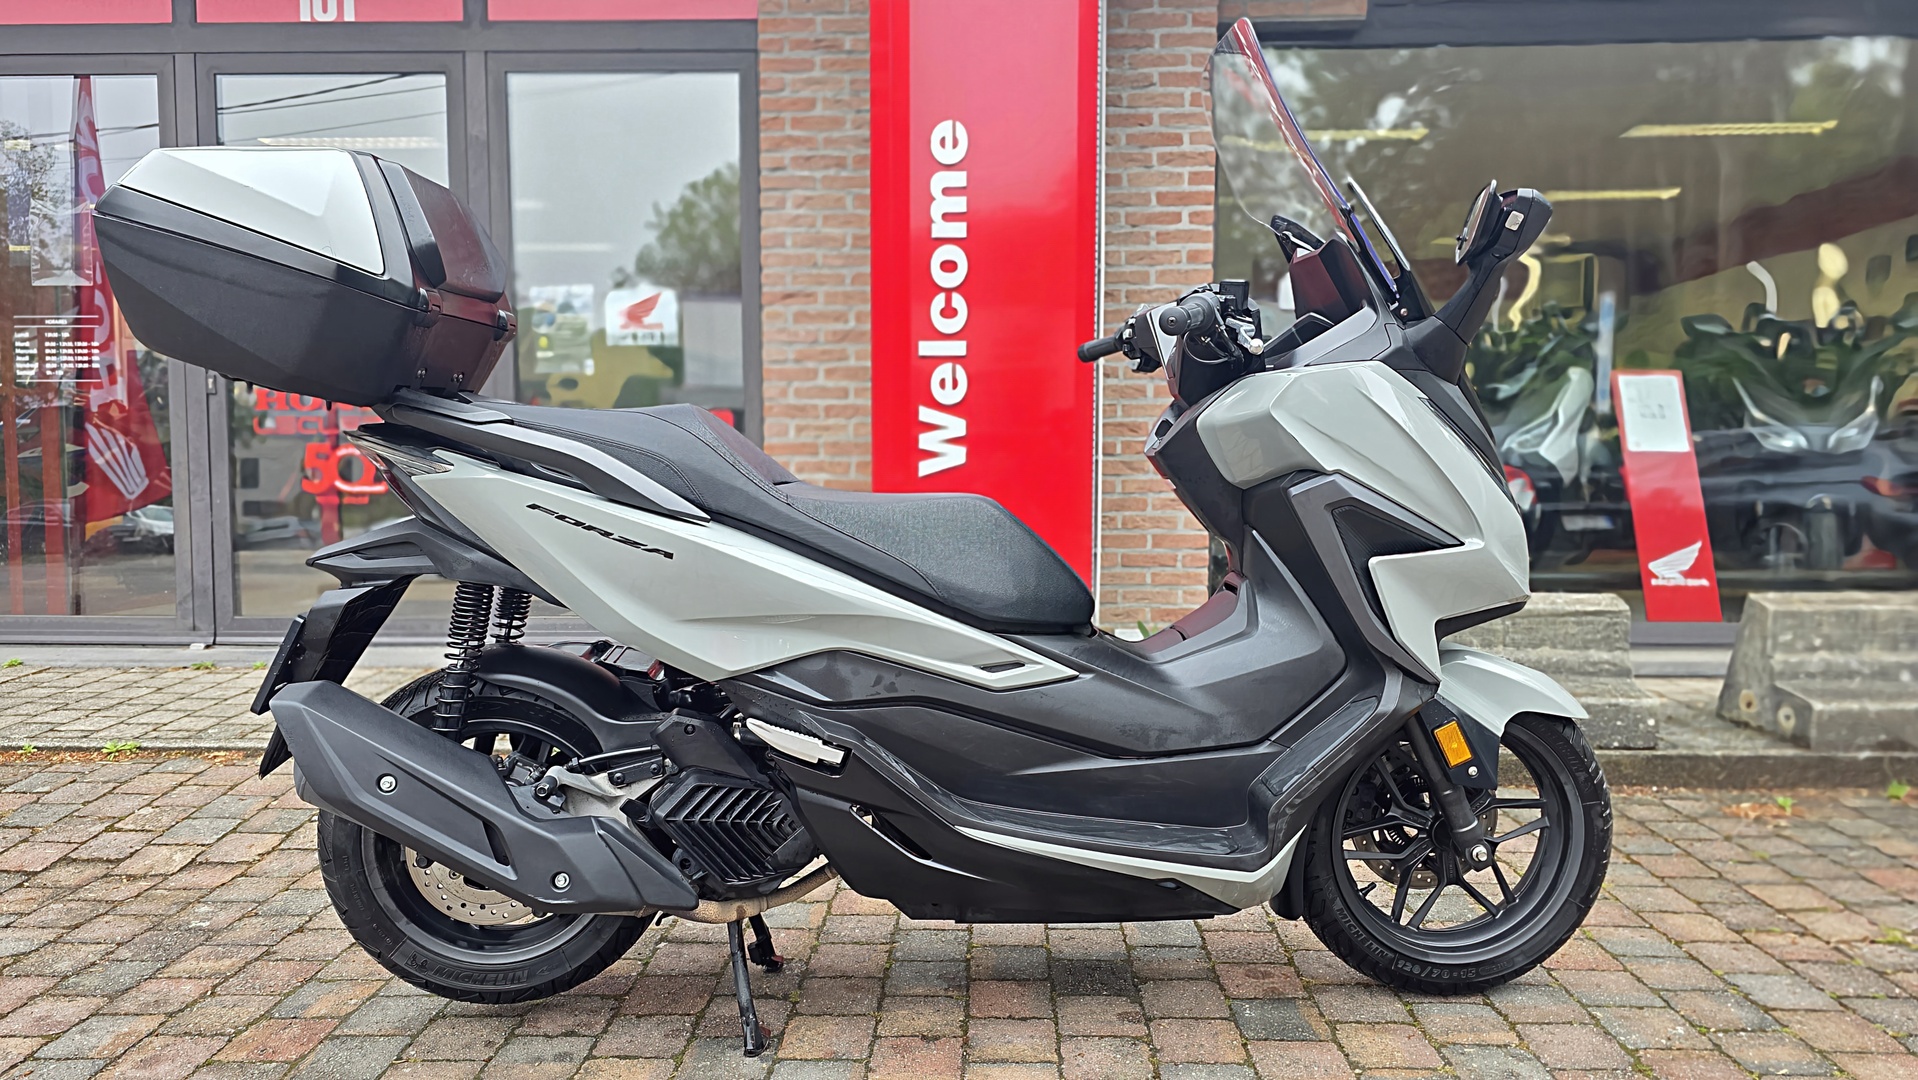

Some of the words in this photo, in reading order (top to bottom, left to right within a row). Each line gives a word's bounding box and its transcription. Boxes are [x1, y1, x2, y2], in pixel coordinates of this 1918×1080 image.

[918, 119, 969, 478] Welcome
[525, 503, 674, 560] FORZA
[1336, 906, 1395, 958] MICHELIN
[431, 964, 529, 986] MICHELIN
